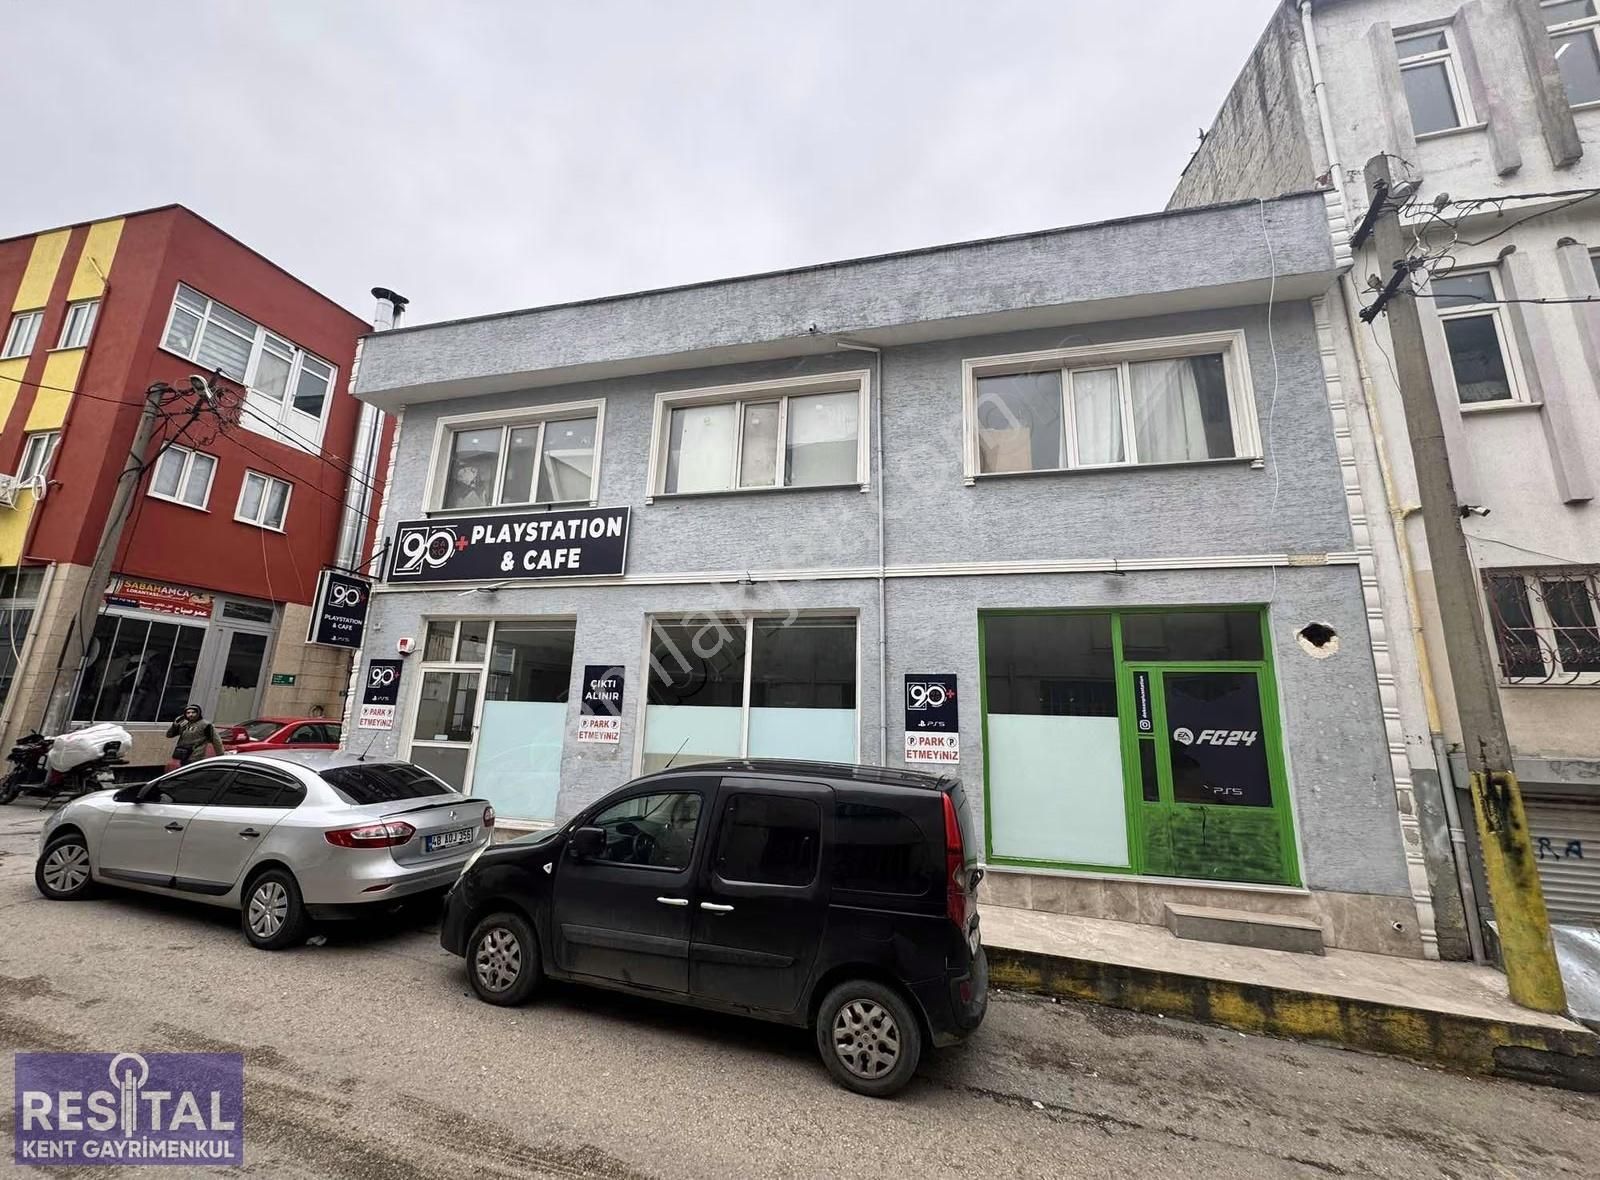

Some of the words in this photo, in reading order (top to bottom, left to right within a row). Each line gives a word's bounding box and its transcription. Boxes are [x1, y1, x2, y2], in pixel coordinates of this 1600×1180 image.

[470, 516, 623, 545] PLAYSTATION
[500, 550, 515, 571] &
[523, 547, 582, 570] CAFE
[324, 613, 363, 625] PLAYSTATION
[338, 623, 353, 631] CAFE
[590, 679, 616, 690] ÇIKTI
[585, 691, 619, 700] ALINIR
[369, 708, 386, 716] PARK
[590, 720, 610, 728] PARK
[919, 737, 944, 746] PARK
[1196, 729, 1257, 746] FC24
[1213, 786, 1243, 795] PS5
[459, 830, 471, 841] 356
